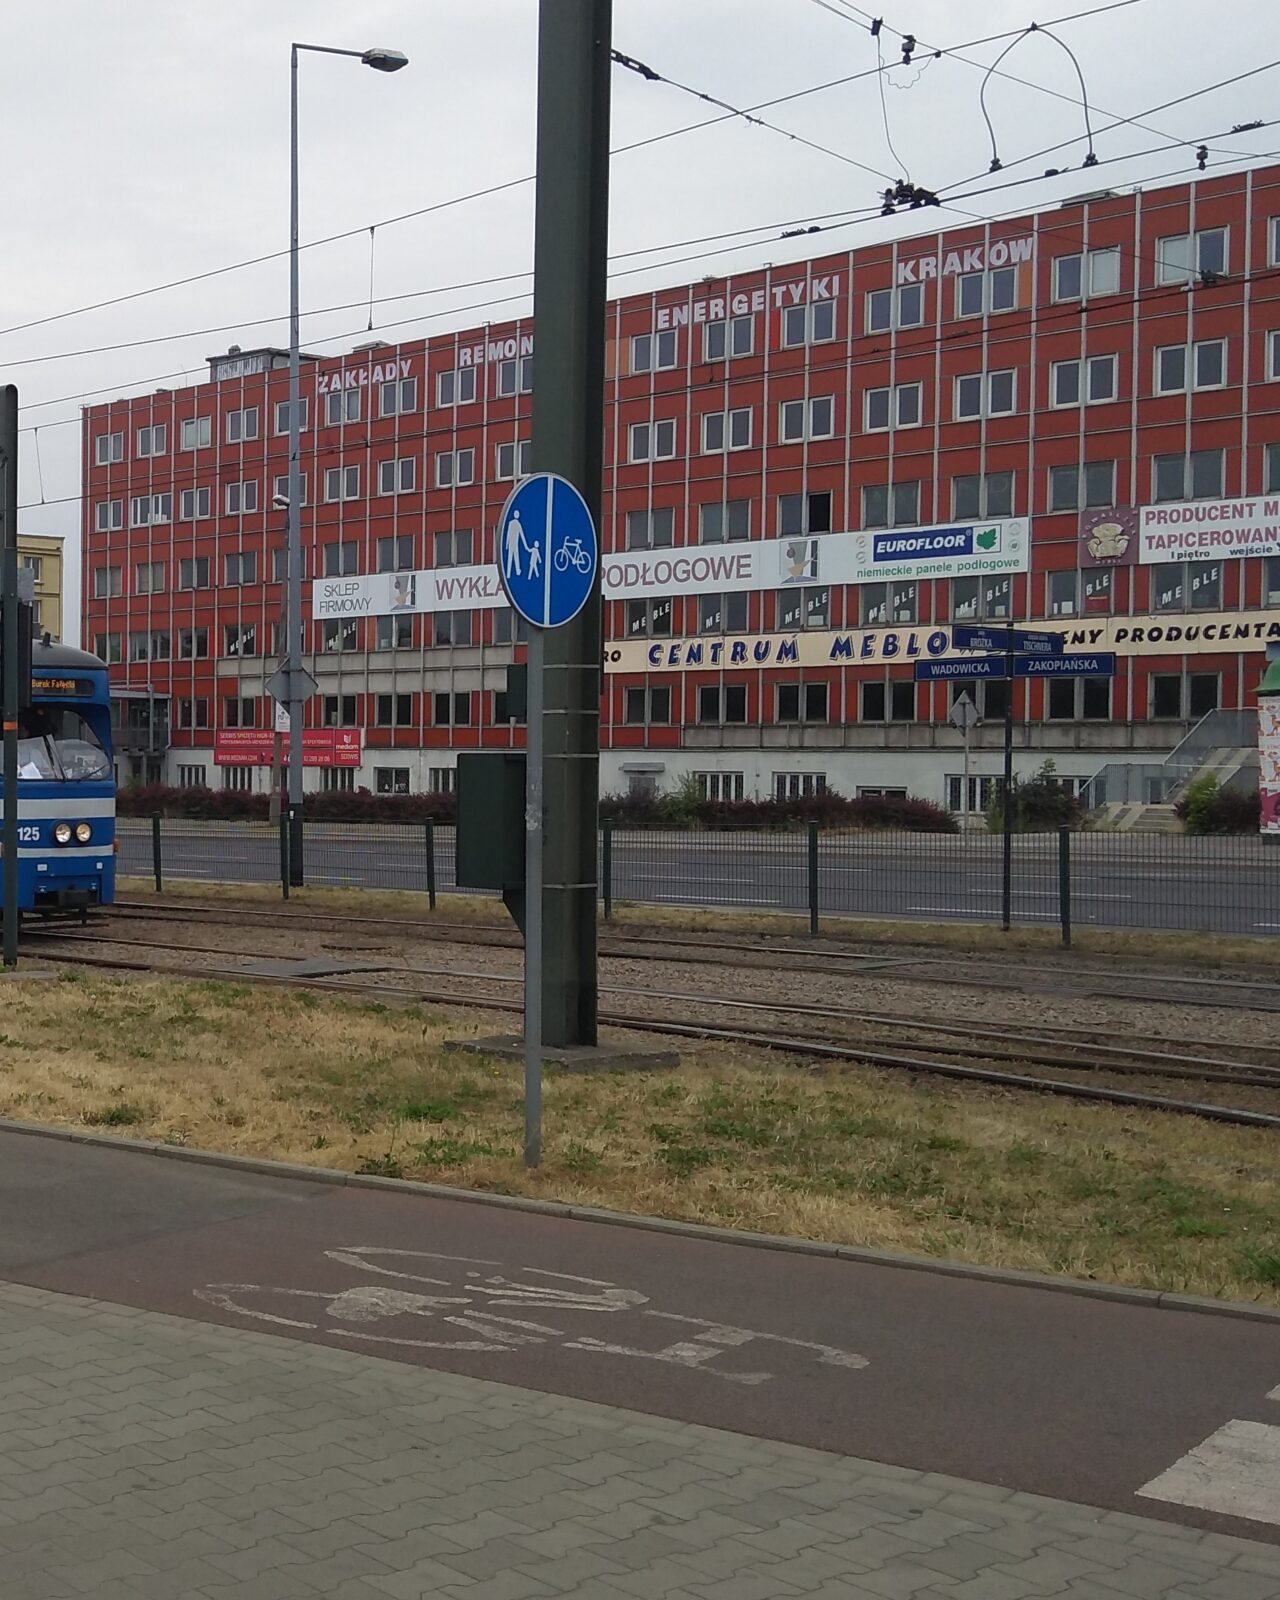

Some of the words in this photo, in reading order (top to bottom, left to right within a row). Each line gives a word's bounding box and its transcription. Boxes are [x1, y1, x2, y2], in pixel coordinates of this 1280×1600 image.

[318, 359, 413, 393] ZAKŁADY
[658, 275, 840, 329] ENERGETYKI
[898, 238, 1034, 284] KRAKÓW
[1145, 503, 1257, 525] PRODUCENT
[876, 535, 966, 553] EUROFLOOR
[1145, 526, 1280, 550] TAPICEROWAN
[1177, 549, 1211, 560] piętro
[1229, 545, 1273, 556] wejście
[857, 562, 912, 578] niemieckie
[916, 562, 952, 576] panele
[957, 558, 1020, 573] podłogowe
[323, 583, 360, 597] SKLEP
[319, 597, 372, 613] FIRMOWY
[648, 639, 799, 666] CENTRUM
[1115, 621, 1280, 643] PRODUCENTA
[931, 663, 990, 675] WADOWICKA
[1028, 657, 1099, 671] ZAKOPIAŃSKA
[17, 826, 40, 841] 125
